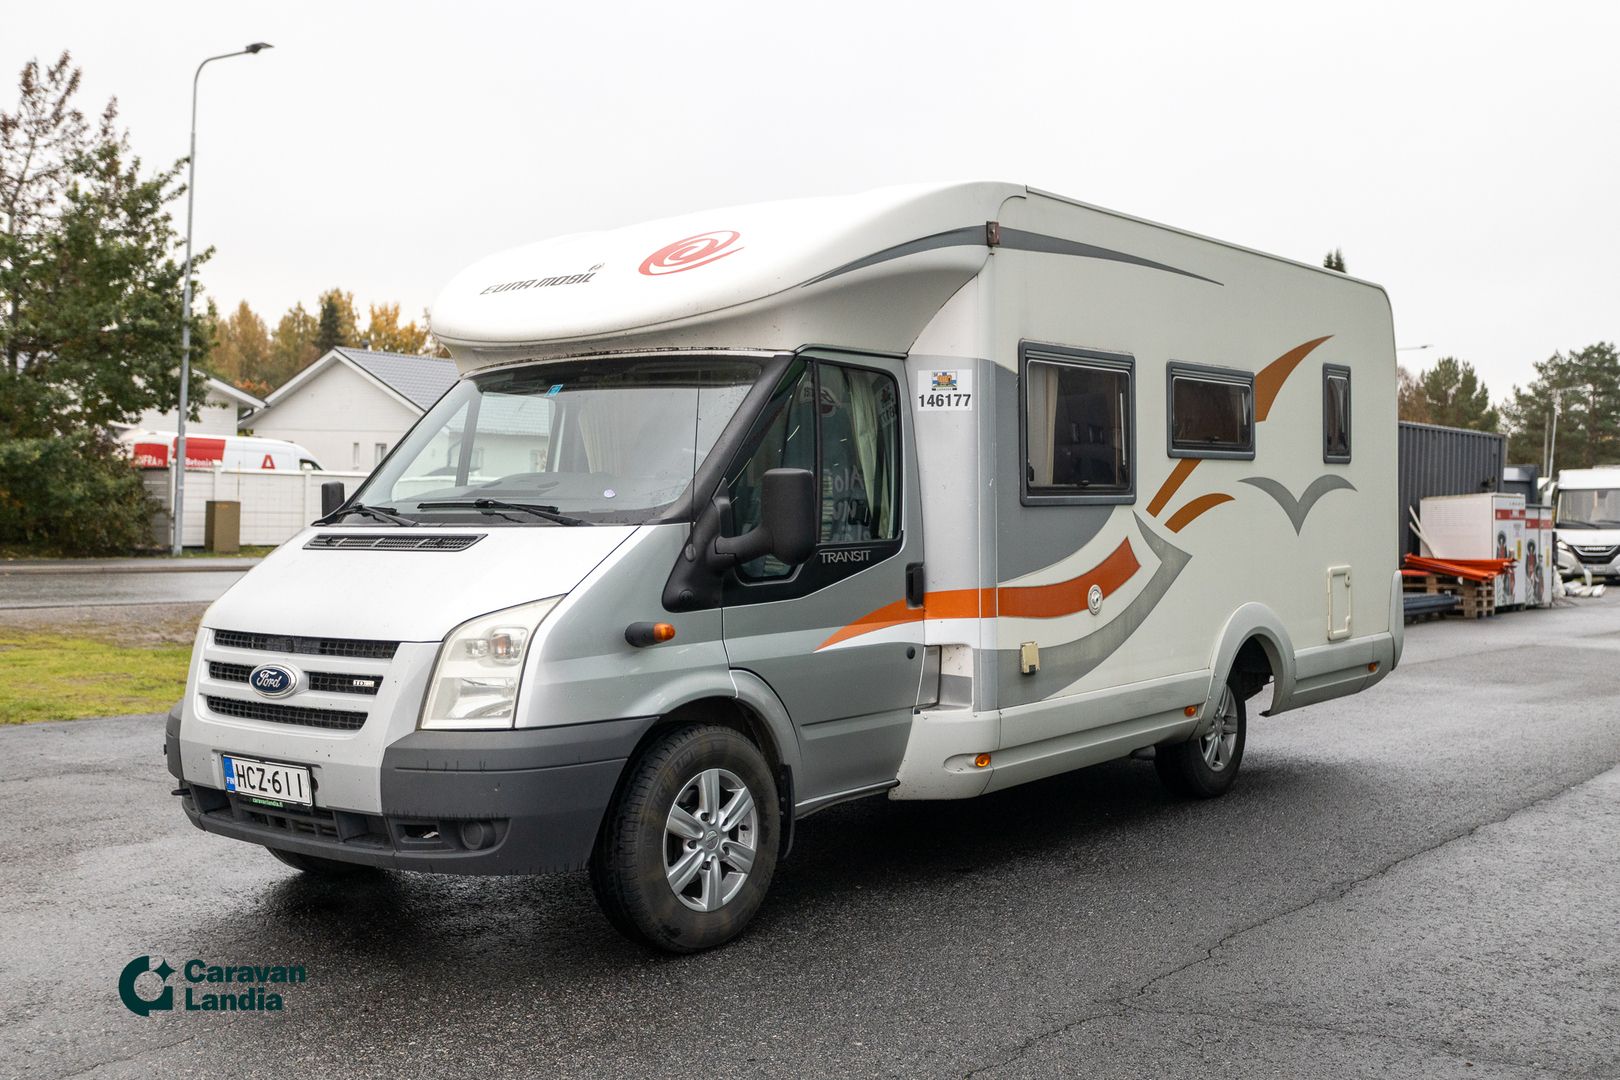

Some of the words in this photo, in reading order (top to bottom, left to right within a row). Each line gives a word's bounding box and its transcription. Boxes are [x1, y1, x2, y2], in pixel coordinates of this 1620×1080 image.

[533, 272, 596, 288] MOBIL
[918, 393, 971, 407] 146177
[820, 550, 871, 563] TRANSIT
[256, 669, 282, 688] Ford
[235, 763, 303, 798] HCZ-611
